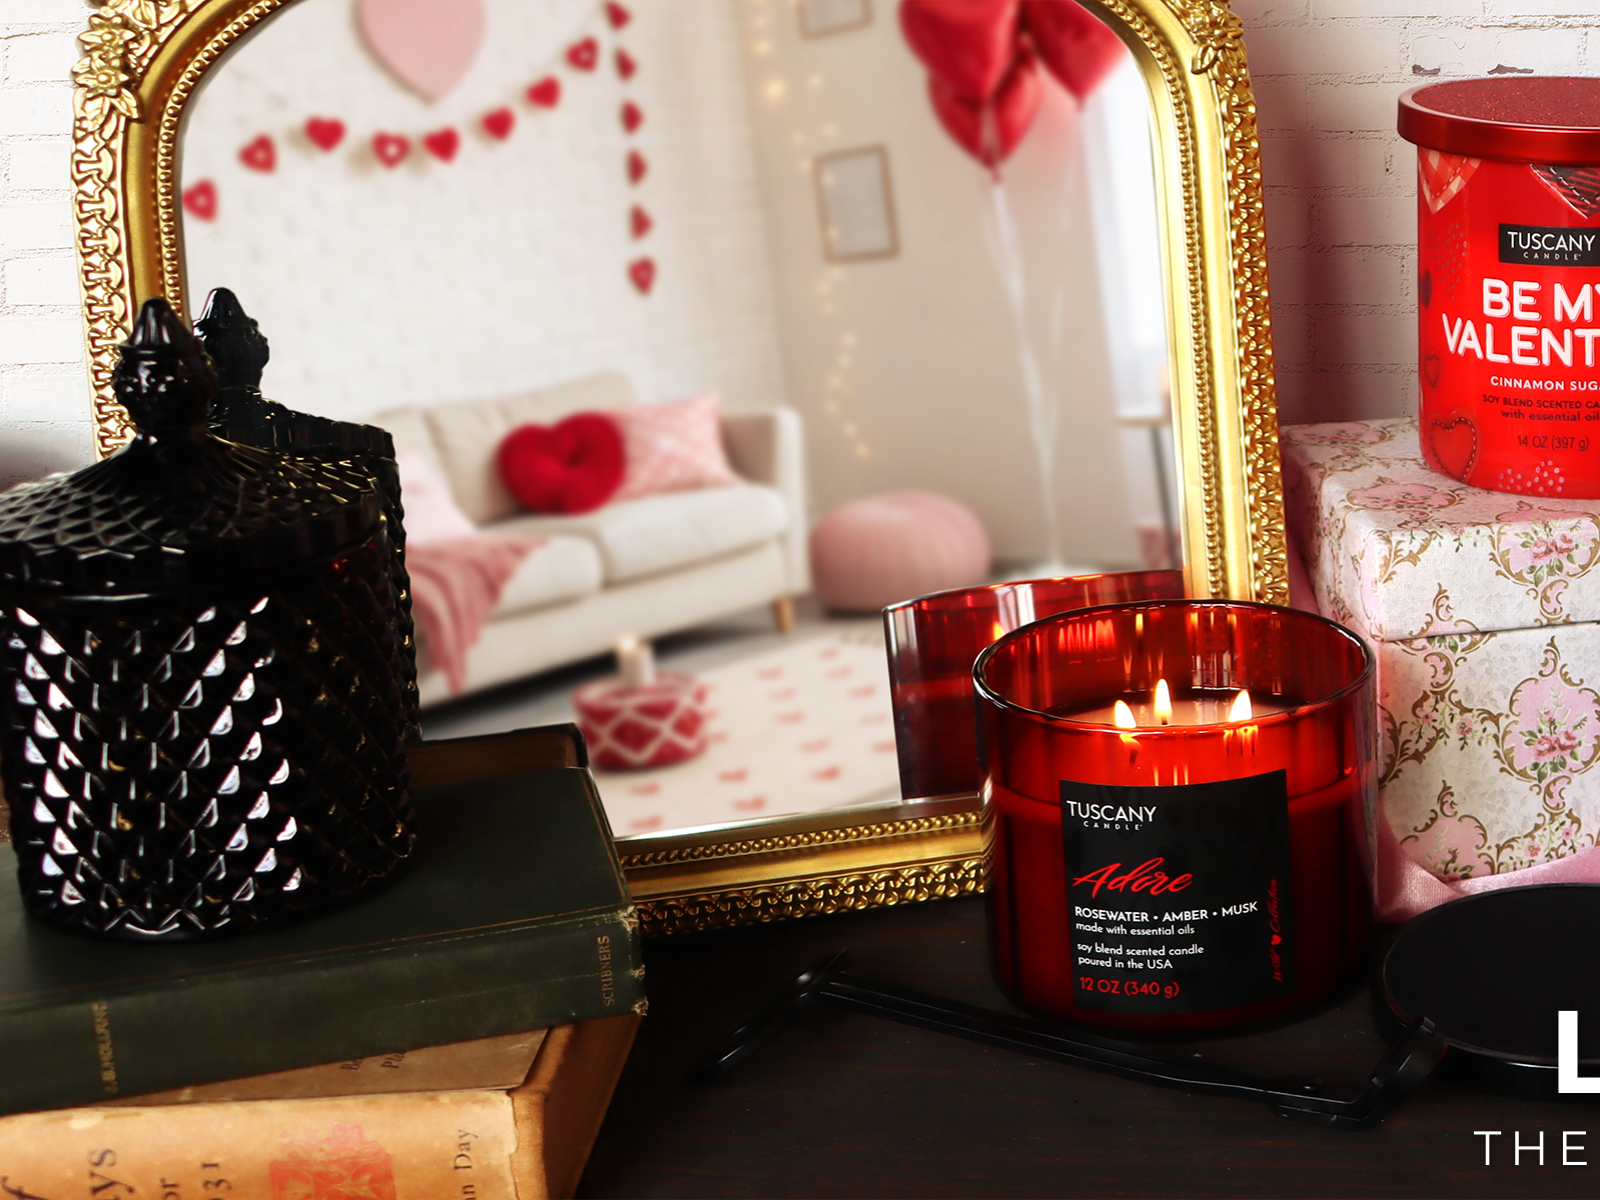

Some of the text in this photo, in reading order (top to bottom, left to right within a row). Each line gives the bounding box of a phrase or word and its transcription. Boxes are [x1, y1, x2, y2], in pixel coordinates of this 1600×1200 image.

[1507, 231, 1596, 252] TUSCANY
[1523, 251, 1582, 261] CANDLE
[1483, 278, 1542, 322] BE
[1490, 376, 1565, 391] CINNAMON
[1482, 394, 1500, 404] SOY
[1503, 397, 1533, 408] BLEND
[1536, 400, 1582, 409] SCENTED
[1501, 409, 1525, 420] with
[1529, 412, 1580, 422] essential
[1517, 435, 1590, 452] 14 OZ (397 g)
[1066, 800, 1157, 822] TUSCANY
[1083, 820, 1143, 831] CANDLE
[1072, 857, 1193, 898] Adore
[1074, 901, 1259, 922] ROSEWATER AMBER MUSK
[1075, 922, 1195, 936] made with essential oils
[1077, 942, 1204, 956] soy blend scented candle
[597, 935, 615, 1007] SCRIBNERS
[1078, 957, 1173, 970] poured in the USA
[1079, 976, 1179, 999] 12 OZ (340 g)
[454, 1129, 479, 1170] Day
